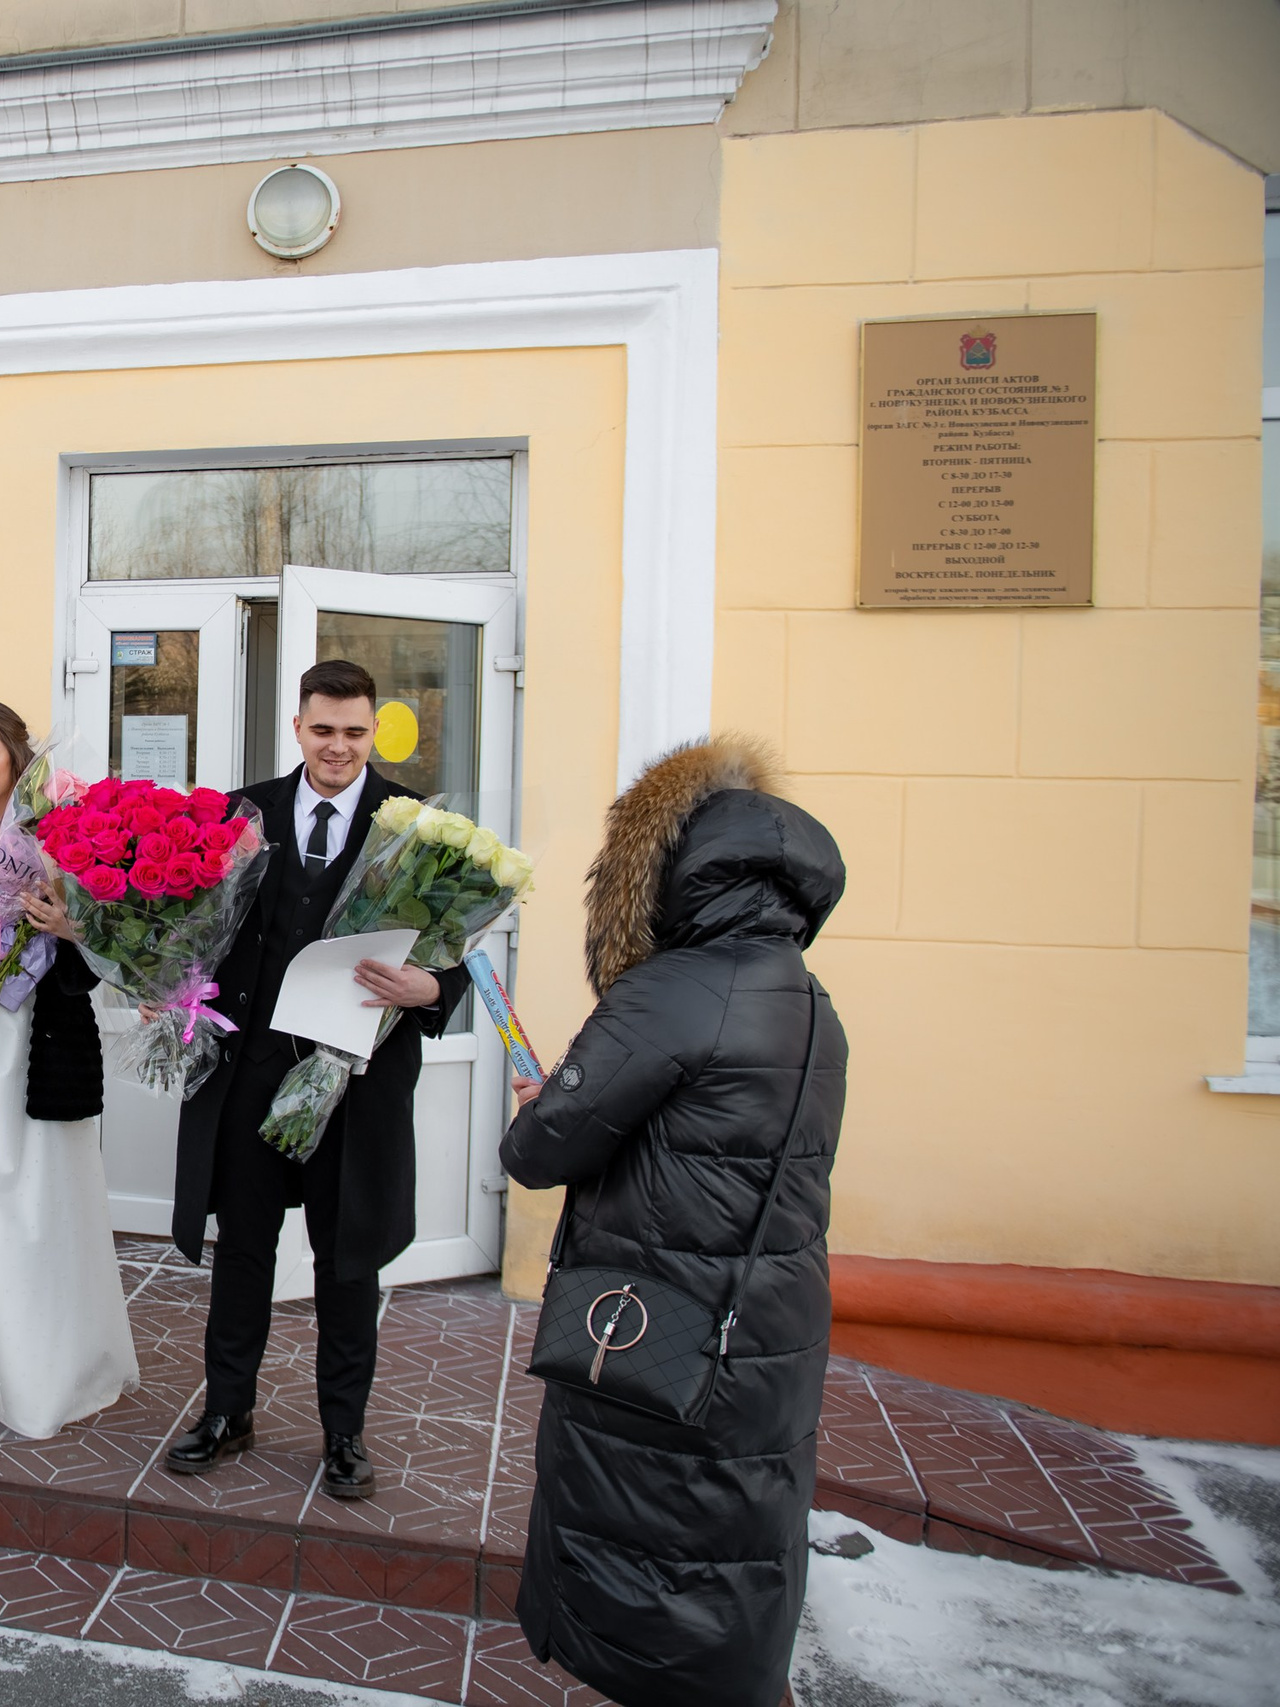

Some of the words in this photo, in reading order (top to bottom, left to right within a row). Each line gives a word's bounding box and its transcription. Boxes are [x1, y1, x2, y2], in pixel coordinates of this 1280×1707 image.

[916, 378, 952, 386] ОРГАН
[954, 376, 999, 385] ЗАПИСИ
[1002, 375, 1039, 384] АКТОВ
[887, 387, 976, 397] ГРАЖДАНСКОГО
[979, 386, 1047, 394] СОСТОЯНИЯ
[1063, 385, 1069, 393] 3
[879, 398, 967, 408] НОВОКУЗНЕЦКА
[980, 396, 1087, 405] НОВОКУЗНЕЦКОГО
[925, 407, 969, 417] РАЙОНА
[972, 407, 1028, 416] КУЗБАССА
[933, 444, 972, 452] РЕЖИМ
[975, 443, 1021, 451] РАБОТЫ:
[922, 458, 972, 467] ВТОРНИК
[980, 457, 1032, 465] ПЯТНИЦА
[950, 472, 969, 480] 8-30
[971, 471, 986, 480] ДО
[989, 471, 1012, 479] 17-30
[952, 486, 1002, 494] ПЕРЕРЫВ
[948, 500, 971, 508] 12-00
[973, 500, 987, 508] ДО
[951, 514, 1000, 522] СУББОТА
[949, 528, 968, 536] 8-30
[970, 528, 985, 537] ДО
[988, 528, 1011, 536] 17-00
[912, 543, 961, 551] ПЕРЕРЫВ
[973, 542, 996, 550] 12-00
[998, 542, 1013, 551] ДО
[945, 555, 1005, 565] ВЫХОДНОЙ
[895, 571, 973, 579] ВОСКРЕСЕНЬЕ,
[976, 570, 1056, 578] ПОНЕДЕЛЬНИК
[484, 988, 497, 1007] ЯРЧЕ
[494, 1008, 518, 1049] ПРАЗДНИК
[515, 1050, 534, 1079] ДЕЛАЙ
